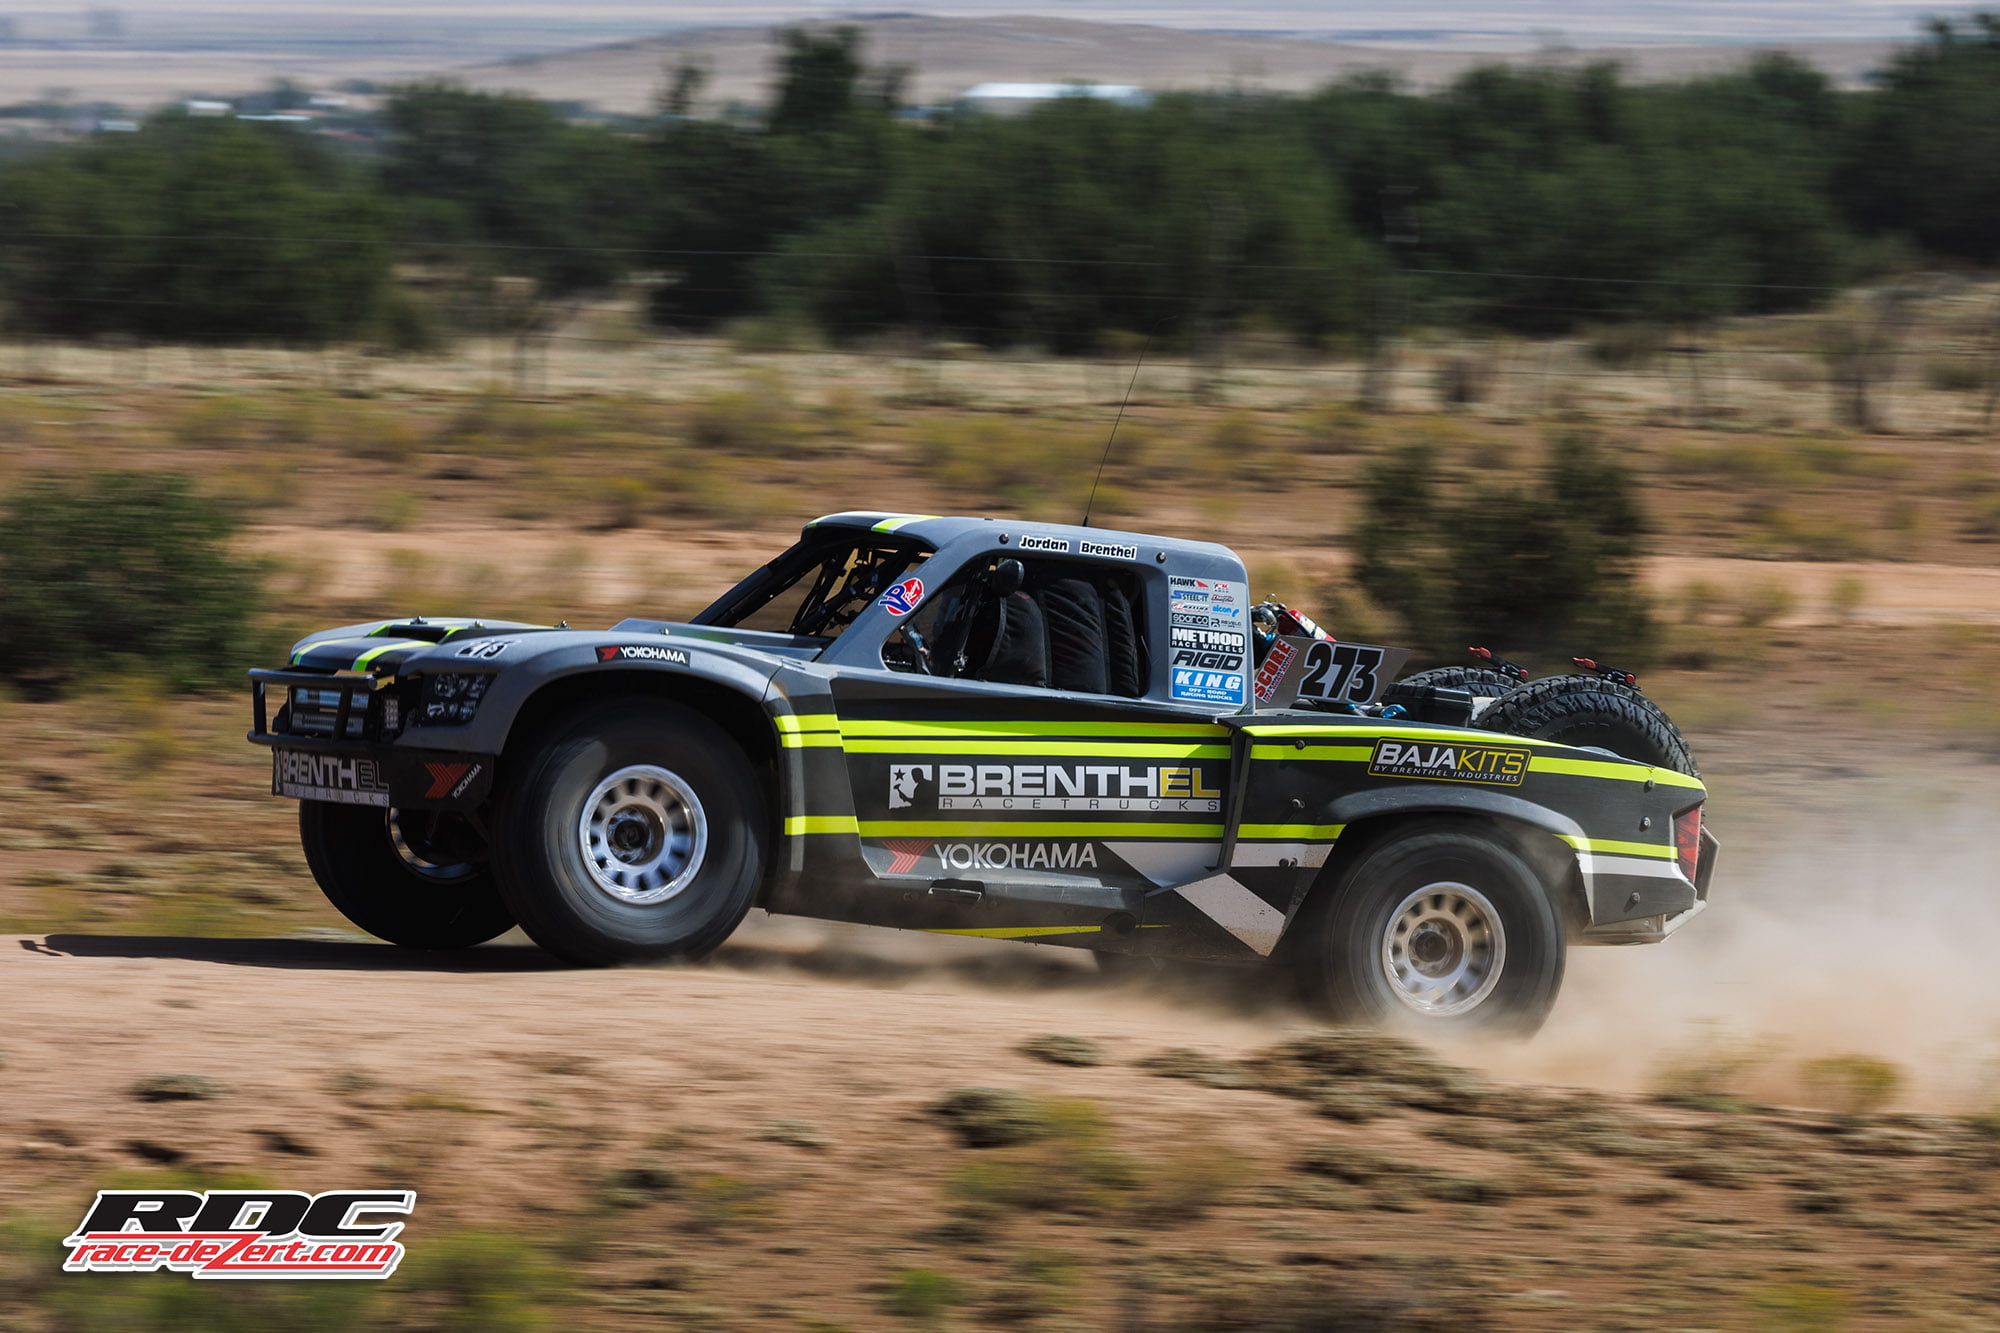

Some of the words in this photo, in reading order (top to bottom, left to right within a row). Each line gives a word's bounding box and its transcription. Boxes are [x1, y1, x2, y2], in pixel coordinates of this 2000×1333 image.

[1021, 537, 1068, 551] Jordan
[1081, 543, 1135, 559] Brenthel
[1170, 577, 1196, 587] HAWK
[1173, 613, 1208, 625] sparco
[1212, 605, 1232, 613] alcon
[1171, 628, 1244, 646] METHOD
[1171, 640, 1197, 649] RACE
[1203, 643, 1243, 653] WHEELS
[620, 646, 687, 664] YOKOHAMA
[1173, 650, 1243, 671] RIGID
[1254, 640, 1291, 698] SCORE
[1299, 642, 1383, 704] 273
[1175, 671, 1241, 690] KING
[1377, 743, 1525, 774] BAJAKITS
[282, 751, 390, 792] BRENTHEL
[452, 763, 483, 799] YOKOHAMA
[939, 765, 1221, 798] BRENTHEL
[1392, 767, 1448, 777] BRENTHEL
[1453, 771, 1518, 782] INDUSTRIES
[942, 798, 1218, 811] RACETRUCKS
[934, 842, 1098, 870] YOKOHAMA
